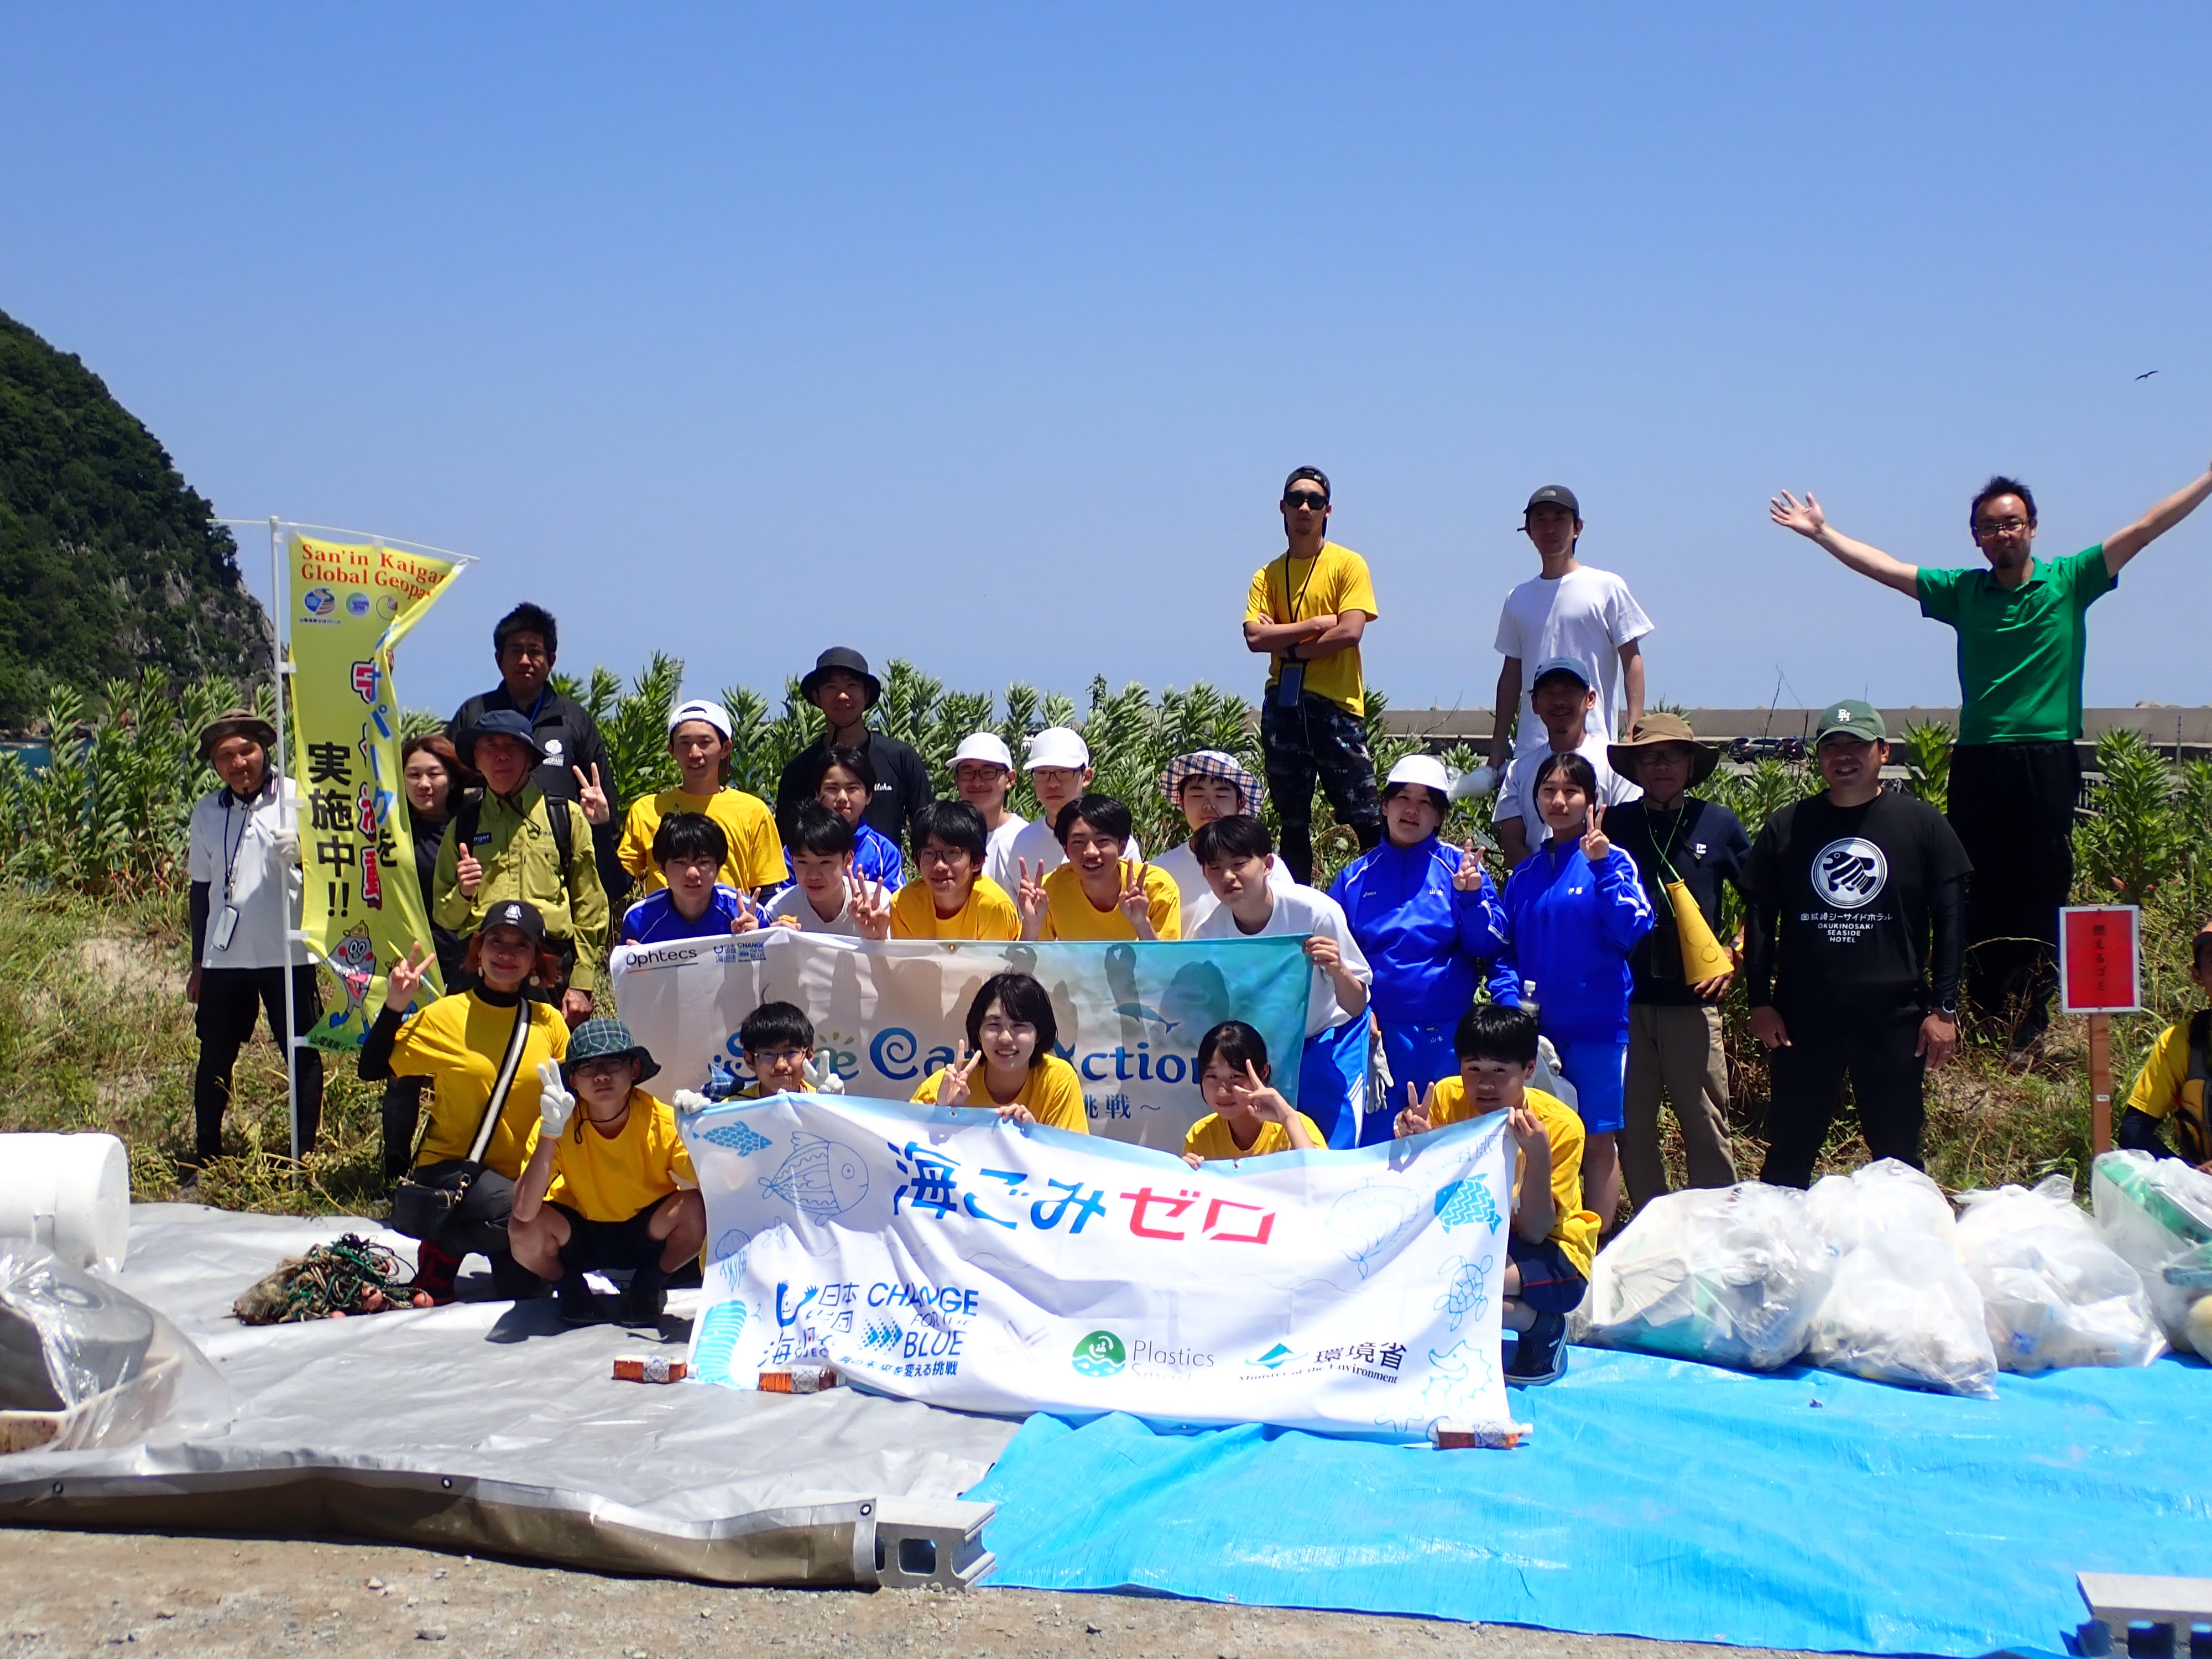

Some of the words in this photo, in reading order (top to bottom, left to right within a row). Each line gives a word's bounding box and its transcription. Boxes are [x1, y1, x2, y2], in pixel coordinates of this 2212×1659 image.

[302, 544, 369, 566] San'in
[301, 563, 368, 584] Global
[374, 570, 431, 600] Geopa
[626, 949, 697, 967] Ophtecs
[887, 1140, 1276, 1245] 海ごみゼロ
[818, 1282, 859, 1307] 日本
[867, 1282, 979, 1317] CHANGE
[903, 1329, 967, 1358] BLUE
[1133, 1340, 1215, 1367] Plastics
[1313, 1342, 1407, 1371] 環境省
[1329, 1363, 1399, 1384] Environment
